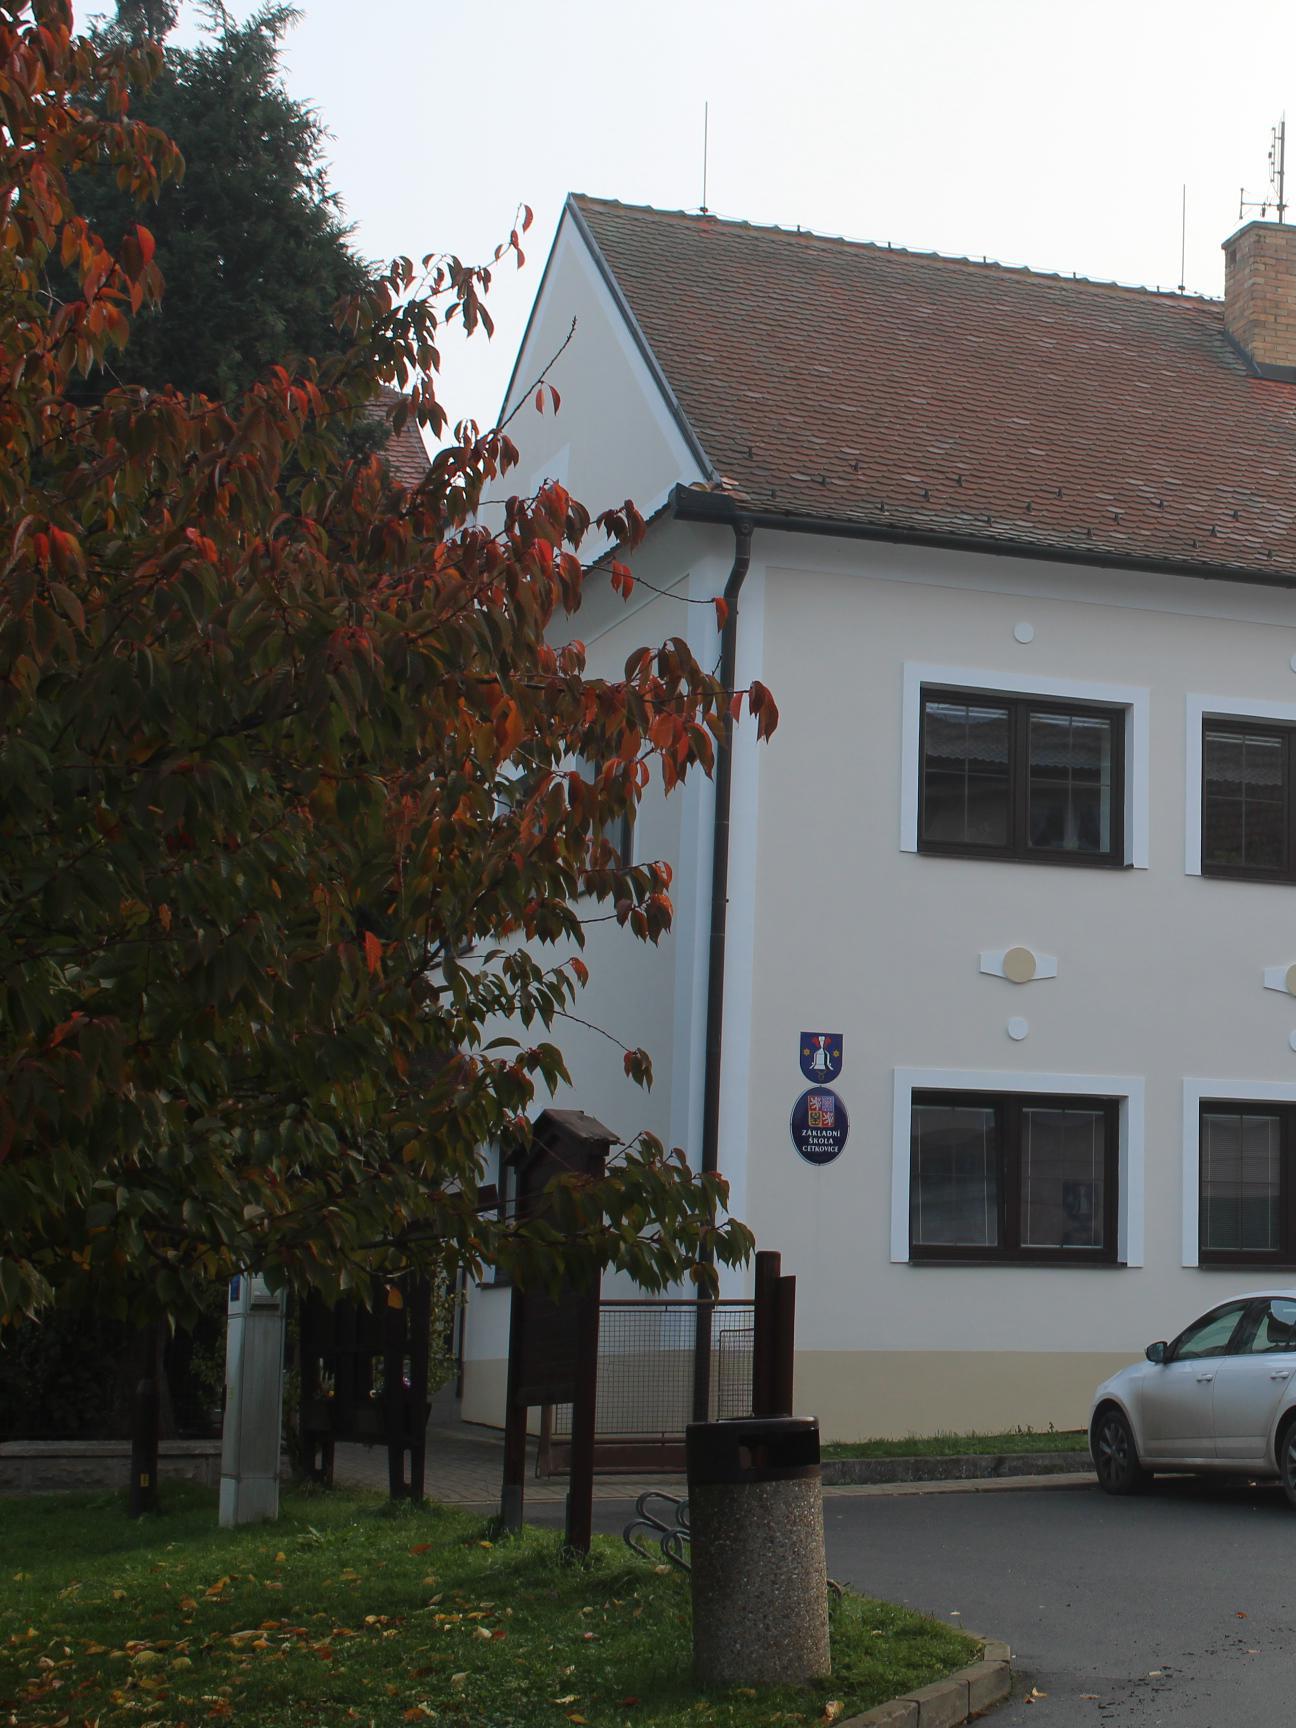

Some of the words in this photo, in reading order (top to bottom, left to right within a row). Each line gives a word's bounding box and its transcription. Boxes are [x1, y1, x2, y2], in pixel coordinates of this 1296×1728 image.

[801, 1128, 840, 1137] ZÁKLADNÍ
[808, 1136, 834, 1145] ŠKOLA
[802, 1145, 839, 1153] CETKOVICE
